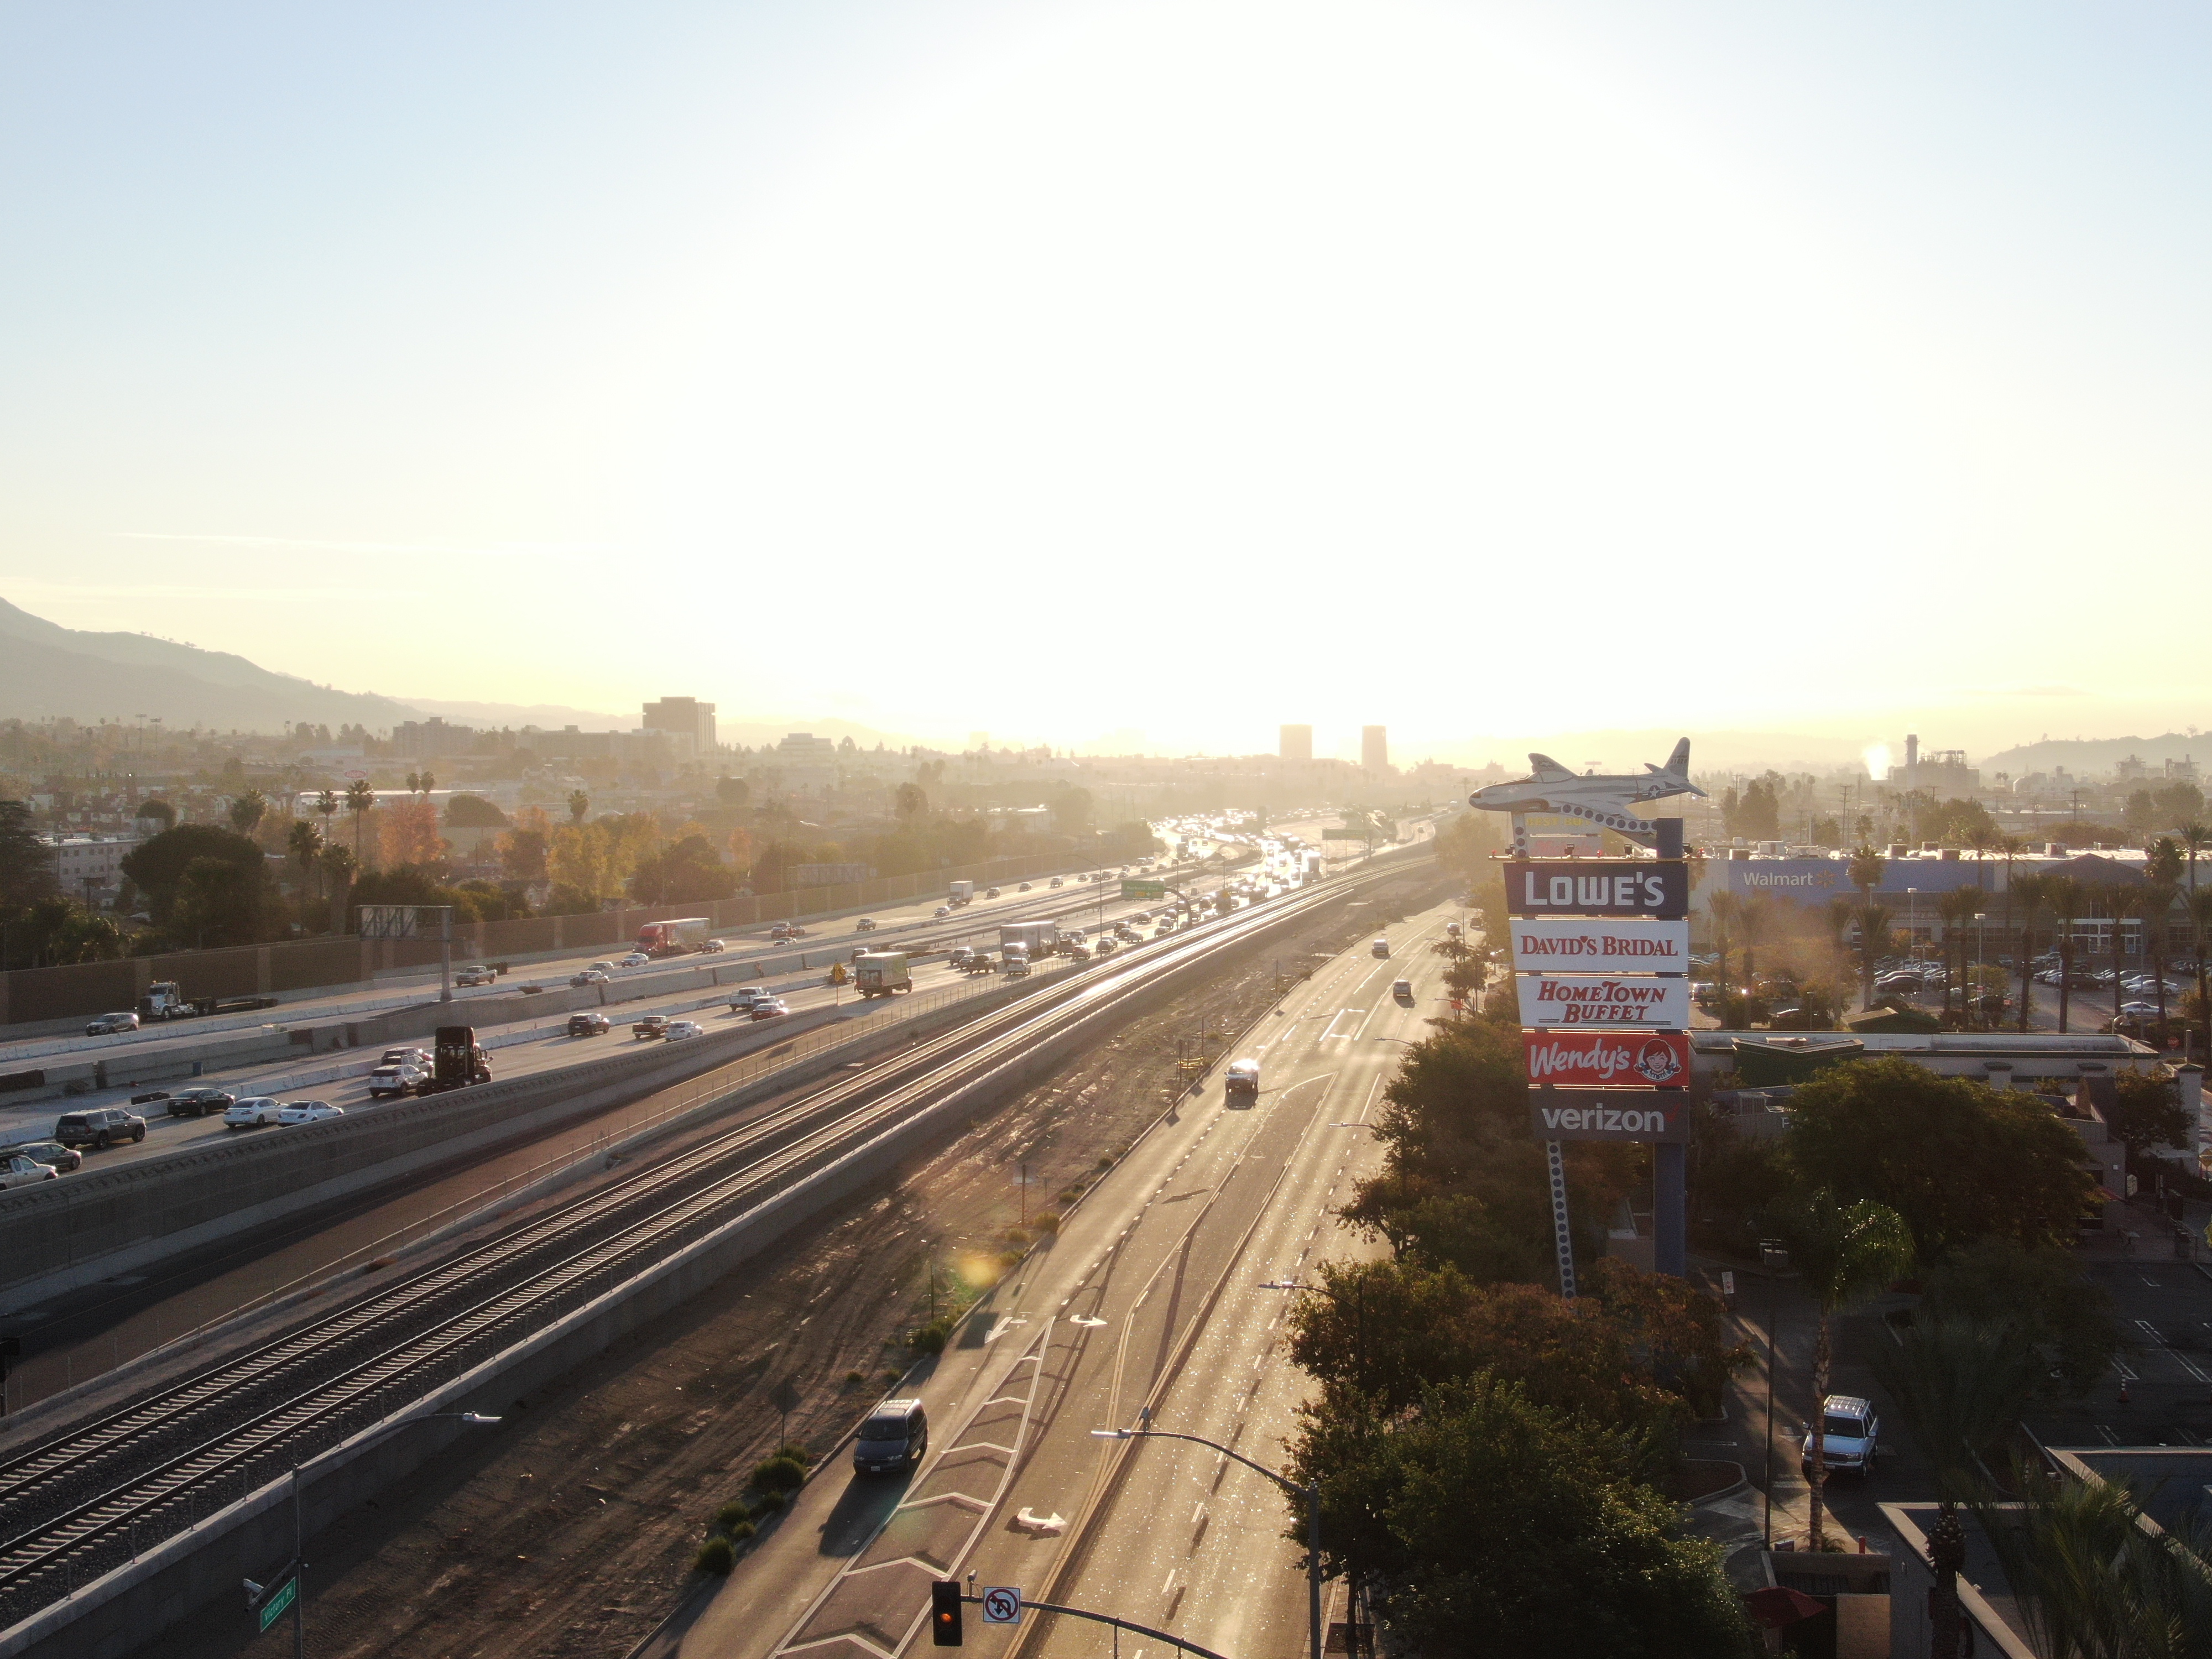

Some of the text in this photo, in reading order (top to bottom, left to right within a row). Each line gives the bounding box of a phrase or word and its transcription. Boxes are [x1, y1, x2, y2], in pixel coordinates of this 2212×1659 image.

[1527, 817, 1558, 826] BEST
[1526, 872, 1665, 906] LOWE'S
[1743, 872, 1813, 886] Walmart
[1521, 935, 1678, 956] DAVID'S BRIDAL
[1537, 980, 1667, 1003] HOMETOWN
[1561, 1003, 1650, 1024] BUFFET
[1530, 1038, 1630, 1079] Wendy's
[1542, 1103, 1665, 1132] verizon
[264, 1585, 293, 1621] Victory Pl
